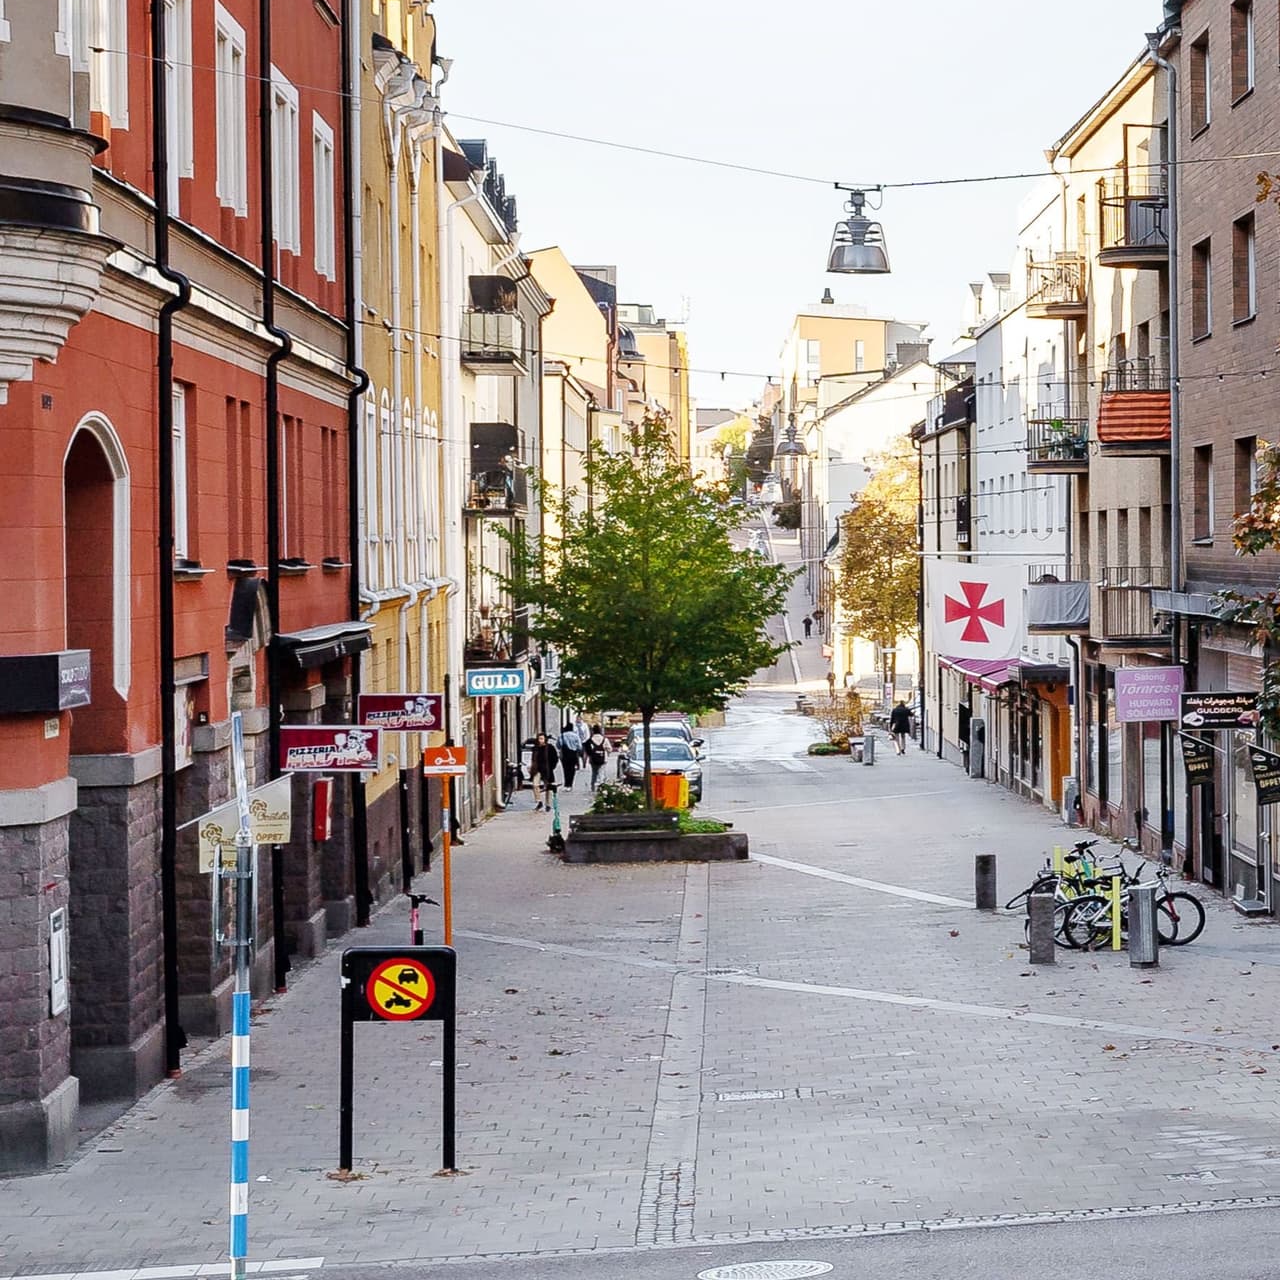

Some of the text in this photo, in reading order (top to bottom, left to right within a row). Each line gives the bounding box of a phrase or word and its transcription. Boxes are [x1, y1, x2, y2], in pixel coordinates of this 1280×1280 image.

[471, 674, 520, 690] GULD
[1134, 672, 1166, 682] Salong
[1126, 708, 1176, 719] SOLARIUM
[289, 746, 336, 756] PIZZERIA
